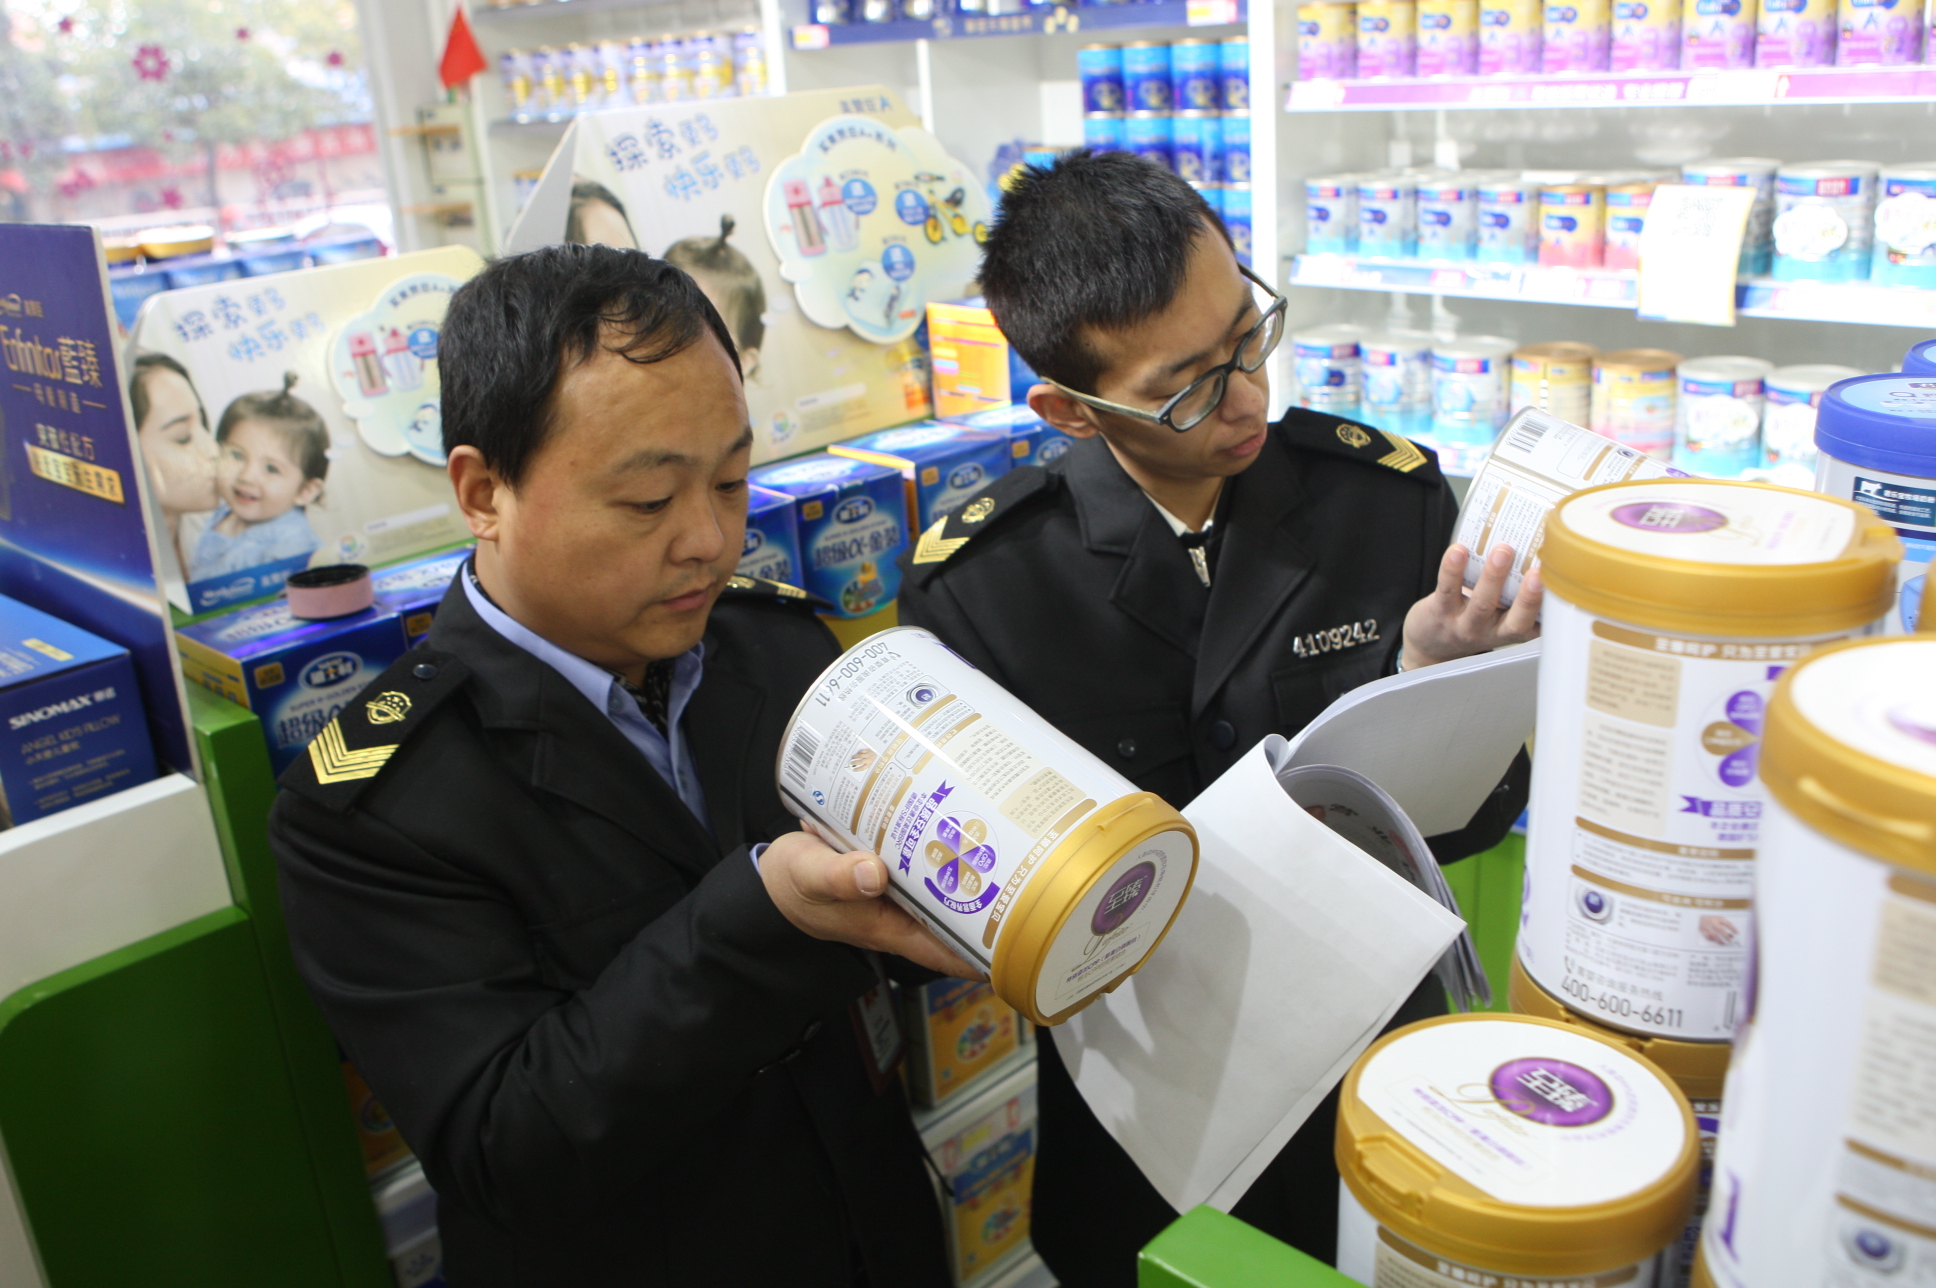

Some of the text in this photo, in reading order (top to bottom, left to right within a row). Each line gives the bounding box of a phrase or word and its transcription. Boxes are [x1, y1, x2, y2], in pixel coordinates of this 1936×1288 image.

[1292, 618, 1381, 659] 4109242
[818, 642, 888, 706] 400-600-6611
[839, 657, 889, 701] 育婴咨询服务热线
[8, 694, 93, 730] SINOMAX
[900, 796, 938, 859] 品质安全可靠
[990, 828, 1059, 922] 至臻呵护 只为至爱宝贝
[1561, 975, 1684, 1028] 400-600-6611
